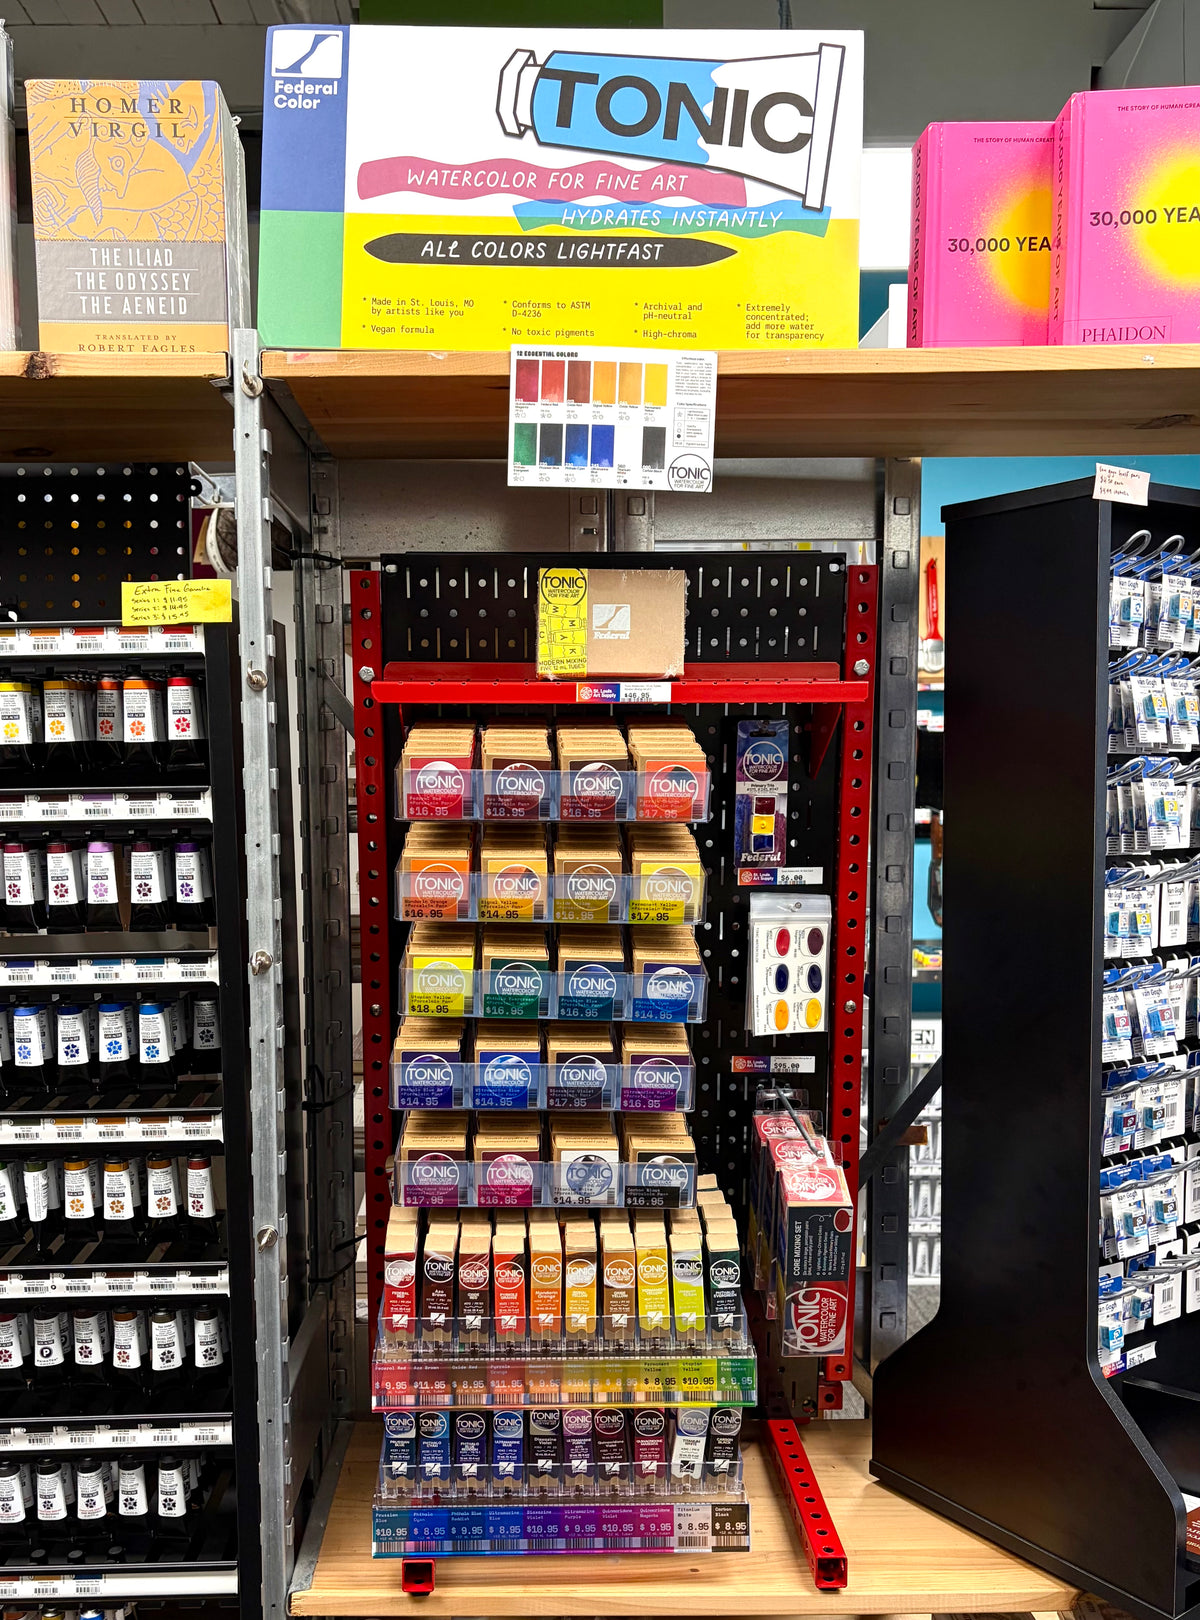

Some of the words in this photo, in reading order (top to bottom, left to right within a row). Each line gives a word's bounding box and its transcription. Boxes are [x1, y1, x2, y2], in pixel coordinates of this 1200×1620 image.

[274, 80, 338, 96] Federal
[70, 97, 184, 115] HOMER
[274, 94, 321, 110] Color
[539, 67, 815, 154] TONIC
[68, 122, 185, 139] VIRGIL
[407, 168, 537, 191] WATERCOLOR
[548, 172, 585, 191] FOR
[596, 173, 643, 191] FINE
[651, 173, 689, 192] ART
[561, 208, 663, 227] HYDRATES
[672, 209, 783, 228] INSTANTLY
[1089, 210, 1157, 228] 30,000
[1163, 207, 1200, 223] YEA
[913, 216, 921, 272] YEARS
[948, 238, 1010, 255] 30,000
[1016, 236, 1052, 252] YEA
[420, 239, 461, 260] ALL
[471, 239, 546, 260] COLORS
[557, 241, 664, 261] LIGHTFAST
[90, 249, 122, 267] THE
[128, 248, 173, 268] ILIAD
[1055, 254, 1061, 278] OF
[75, 272, 107, 291] THE
[115, 272, 191, 291] ODYSSEY
[913, 275, 919, 303] OF
[80, 296, 112, 314] THE
[122, 296, 188, 315] AENEID
[371, 298, 391, 306] Made
[396, 298, 406, 306] in
[410, 298, 424, 306] St.
[430, 299, 458, 308] Louis,
[463, 299, 474, 307] MO
[512, 301, 551, 309] Conforms
[643, 302, 682, 311] Archival
[687, 303, 702, 311] and
[371, 306, 381, 316] by
[386, 307, 420, 316] artists
[425, 307, 445, 316] like
[449, 310, 464, 318] you
[512, 309, 541, 318] D-4236
[746, 304, 791, 313] Extremely
[643, 311, 692, 321] pH-neutral
[745, 313, 809, 321] concentrated;
[371, 325, 395, 335] Vegan
[400, 326, 434, 334] formula
[746, 322, 761, 330] add
[95, 334, 160, 342] TRANSLATED
[164, 334, 177, 342] BY
[526, 328, 550, 336] toxic
[555, 328, 594, 338] pigments
[643, 330, 697, 339] High-chroma
[746, 331, 761, 339] for
[765, 332, 824, 341] transparency
[1082, 325, 1166, 343] PHAIDON
[78, 344, 135, 352] ROBERT
[141, 344, 195, 352] FAGLES
[669, 467, 711, 480] TONIC
[543, 577, 585, 589] TONIC
[745, 754, 782, 764] TONIC
[418, 776, 462, 789] TONIC
[652, 780, 697, 792] TONIC
[409, 807, 448, 816] $16.95
[639, 810, 677, 818] $17.95
[741, 852, 781, 861] Federal
[417, 878, 463, 890] TONIC
[570, 879, 614, 890] TONIC
[405, 910, 443, 918] $16.95
[481, 911, 518, 919] $14.95
[631, 913, 669, 921] $17.95
[498, 976, 541, 988] TONIC
[1151, 989, 1162, 997] Gogh
[411, 1005, 449, 1014] $18.95
[635, 1011, 672, 1019] $14.95
[408, 1069, 451, 1080] TONIC
[562, 1069, 605, 1080] TONIC
[401, 1098, 438, 1106] $14.95
[548, 1099, 586, 1107] $17.95
[623, 1100, 660, 1108] $16.95
[644, 1169, 686, 1179] TONIC
[480, 1196, 517, 1204] $16.95
[426, 1263, 453, 1271] TONIC
[829, 1297, 838, 1309] ART
[797, 1290, 820, 1349] TONIC
[820, 1298, 829, 1343] WATERCOLOR
[828, 1311, 836, 1327] FINE
[414, 1381, 446, 1390] $11.95
[376, 1528, 407, 1536] $10.95
[527, 1525, 558, 1533] $10.95
[602, 1524, 633, 1532] $10.95
